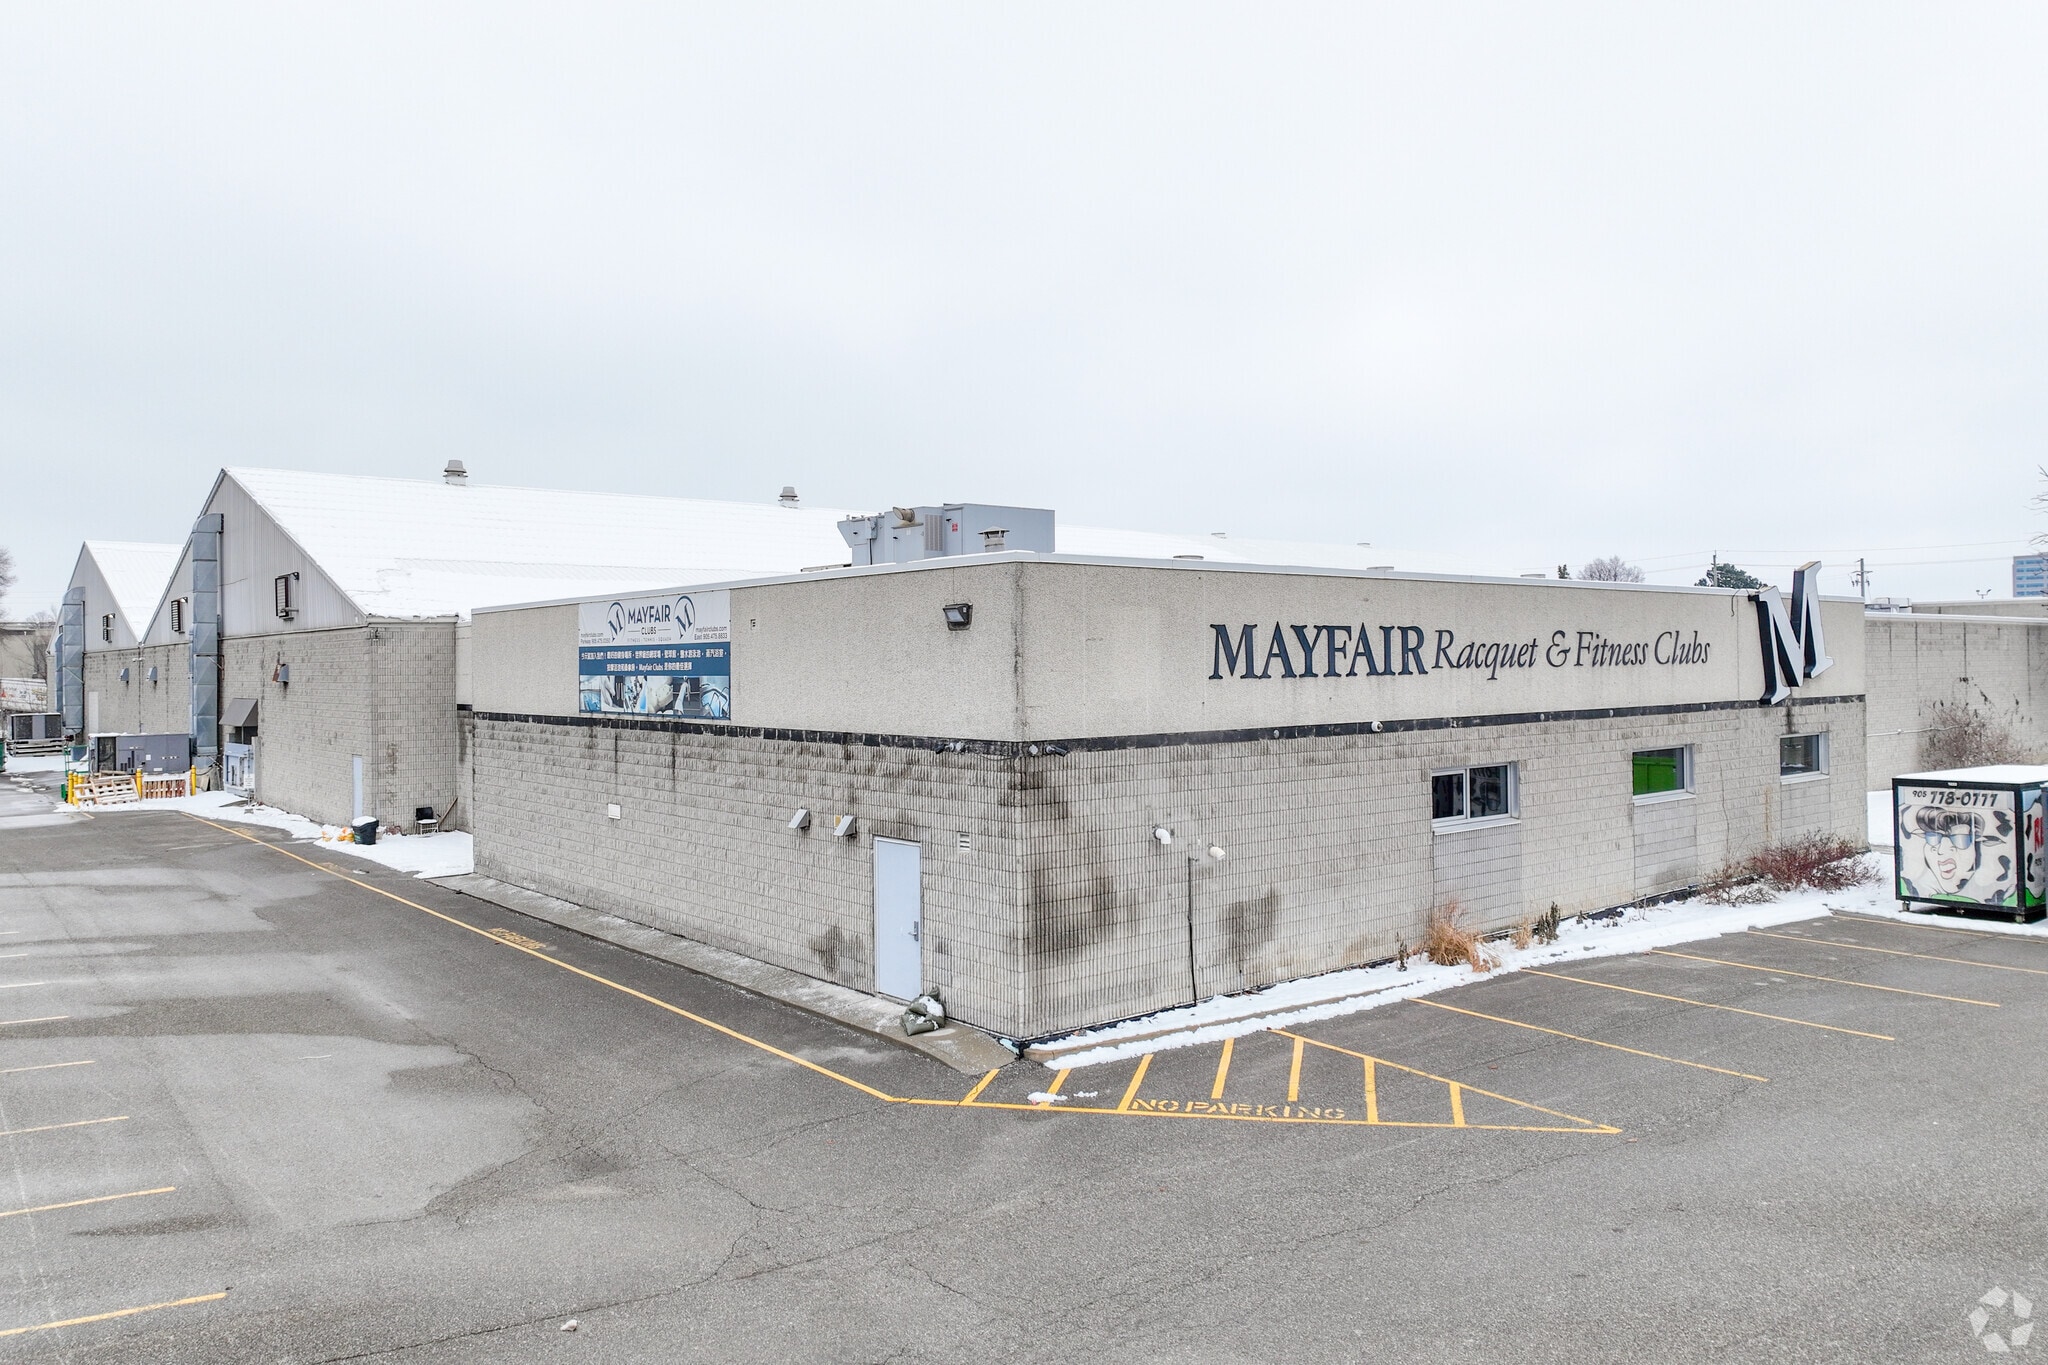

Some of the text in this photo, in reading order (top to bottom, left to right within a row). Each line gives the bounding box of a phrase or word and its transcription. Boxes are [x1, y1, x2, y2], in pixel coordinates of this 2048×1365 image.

[628, 604, 671, 625] MAYFAIR
[641, 626, 657, 635] CLUBS
[1748, 561, 1834, 705] M
[1208, 620, 1711, 681] MAYFAIR Racquet & Fitness Clubs
[638, 663, 652, 672] Mayfair
[1912, 790, 1927, 798] 905
[1131, 1098, 1346, 1119] NO PARKING
